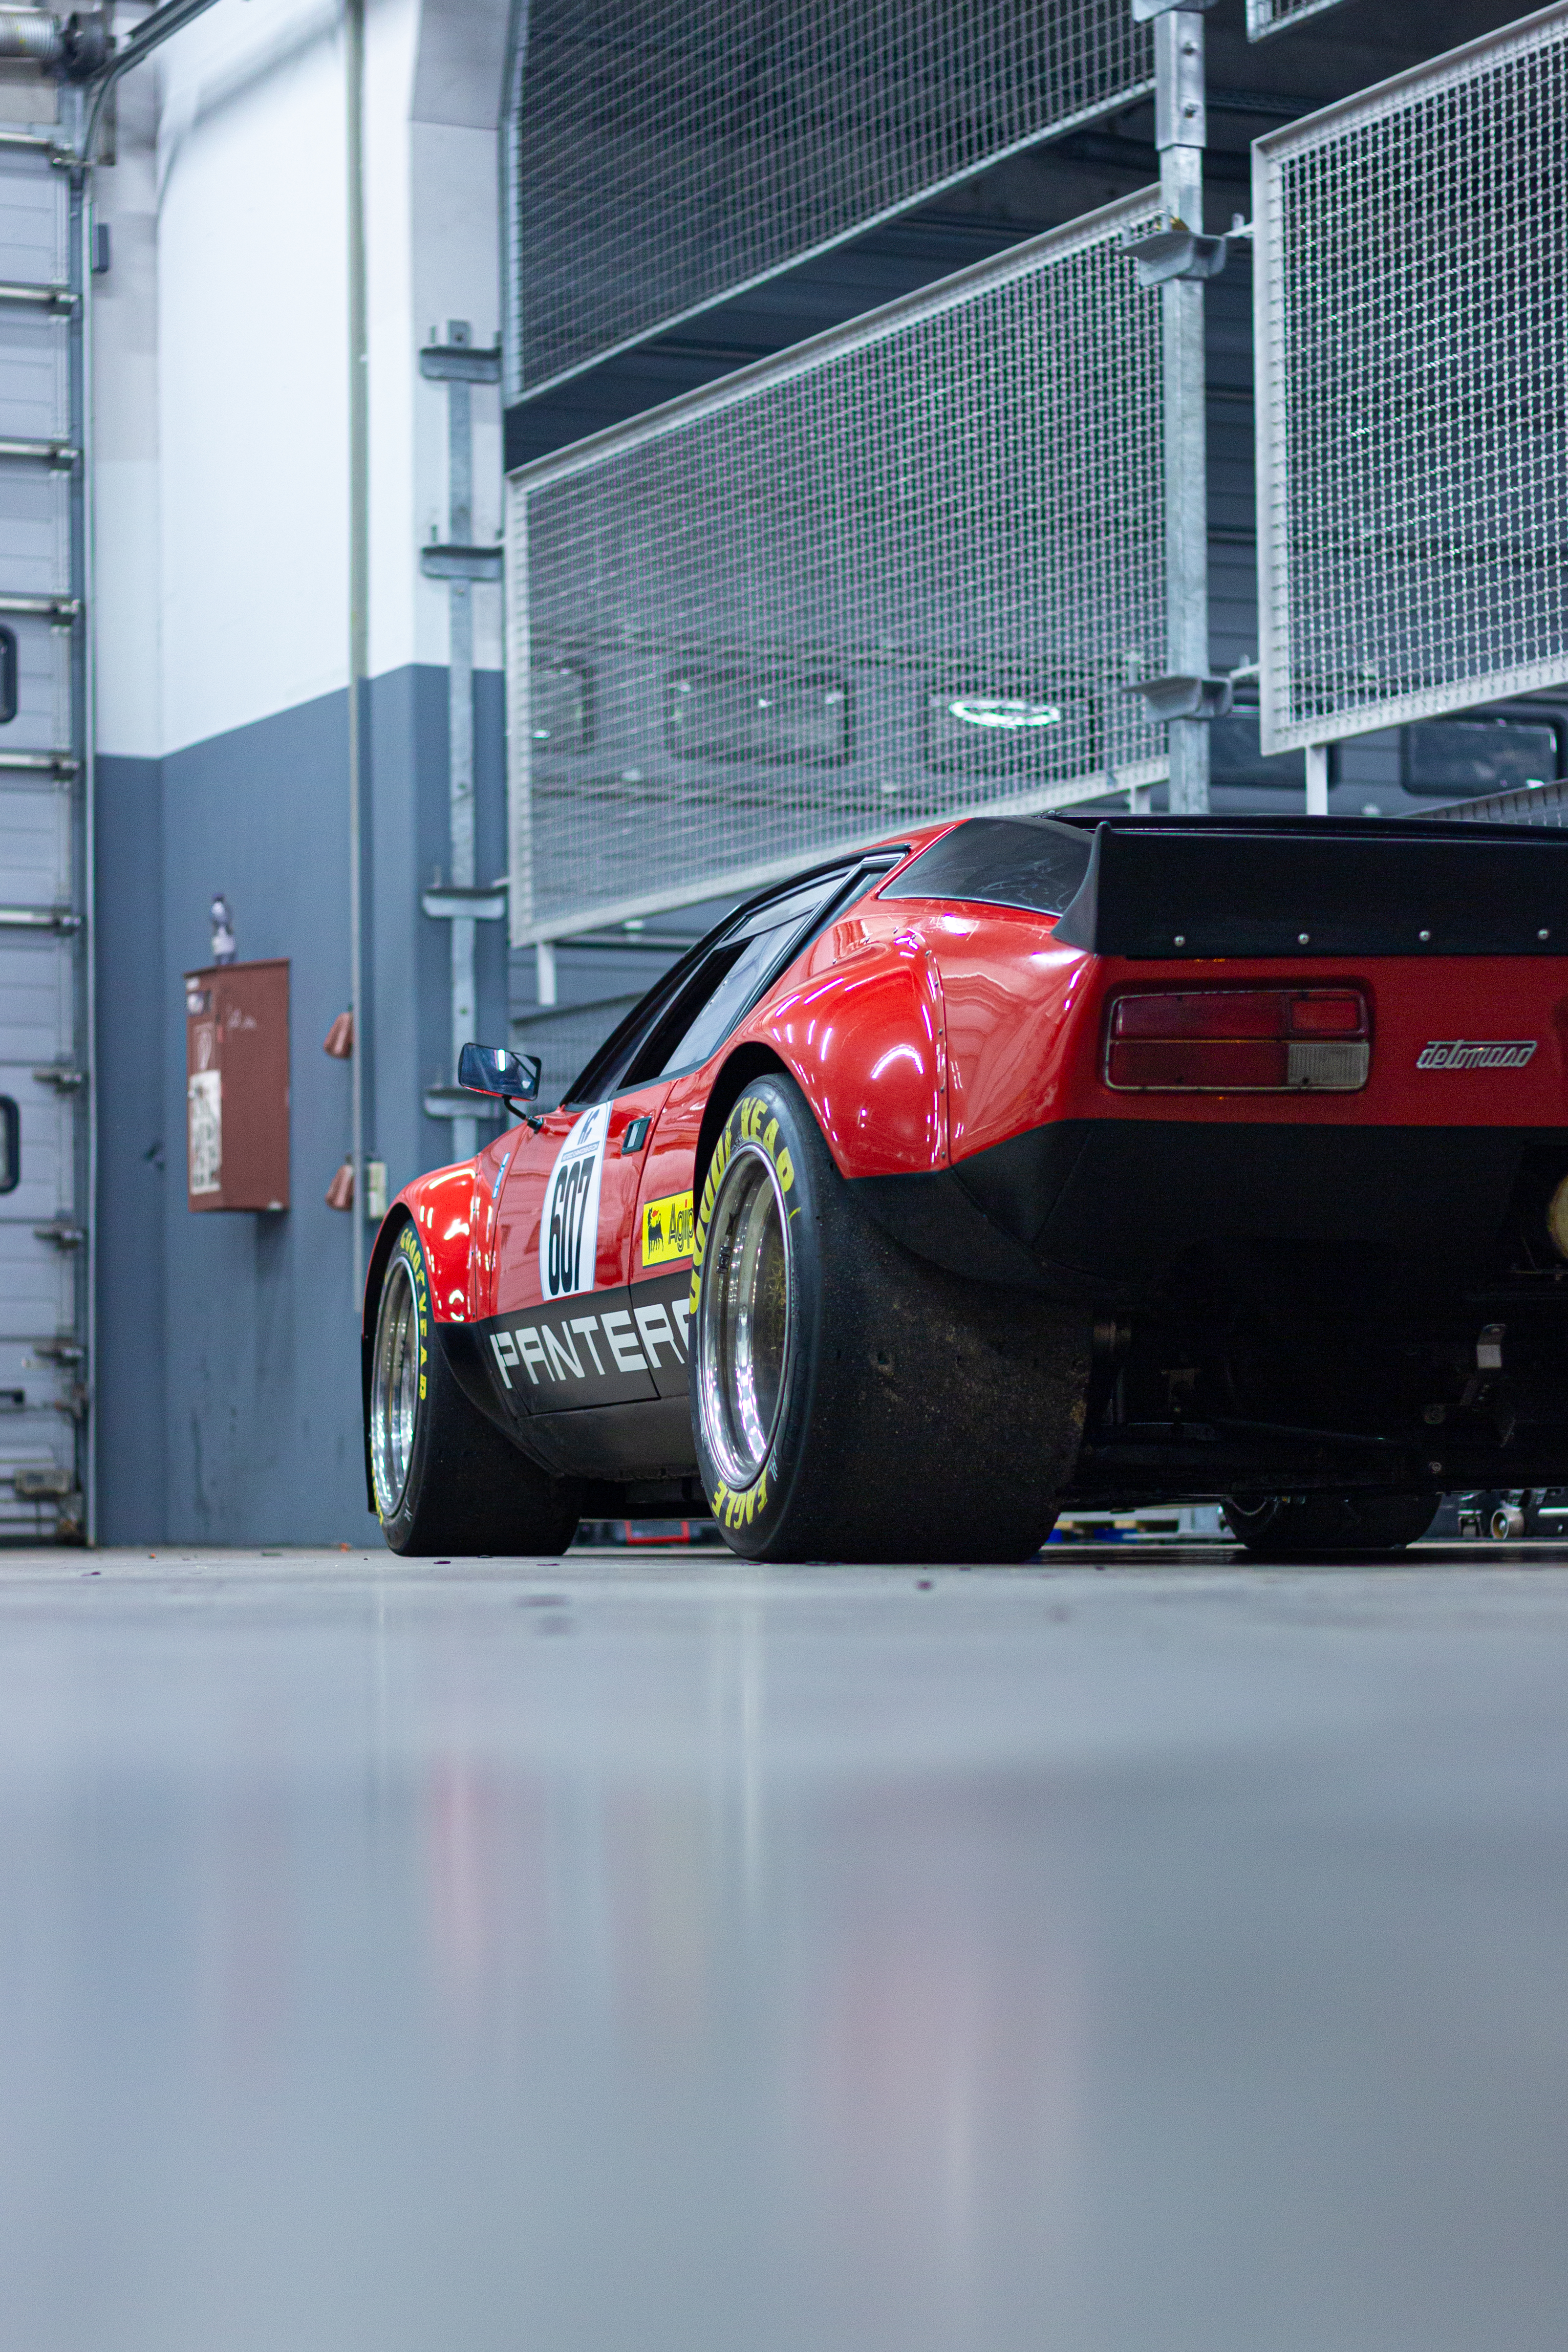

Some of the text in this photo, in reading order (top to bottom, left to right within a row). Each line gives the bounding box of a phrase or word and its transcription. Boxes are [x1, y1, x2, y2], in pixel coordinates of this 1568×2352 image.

[549, 1155, 596, 1296] 607
[668, 1199, 694, 1252] Agip
[711, 1467, 768, 1529] EAGLE
